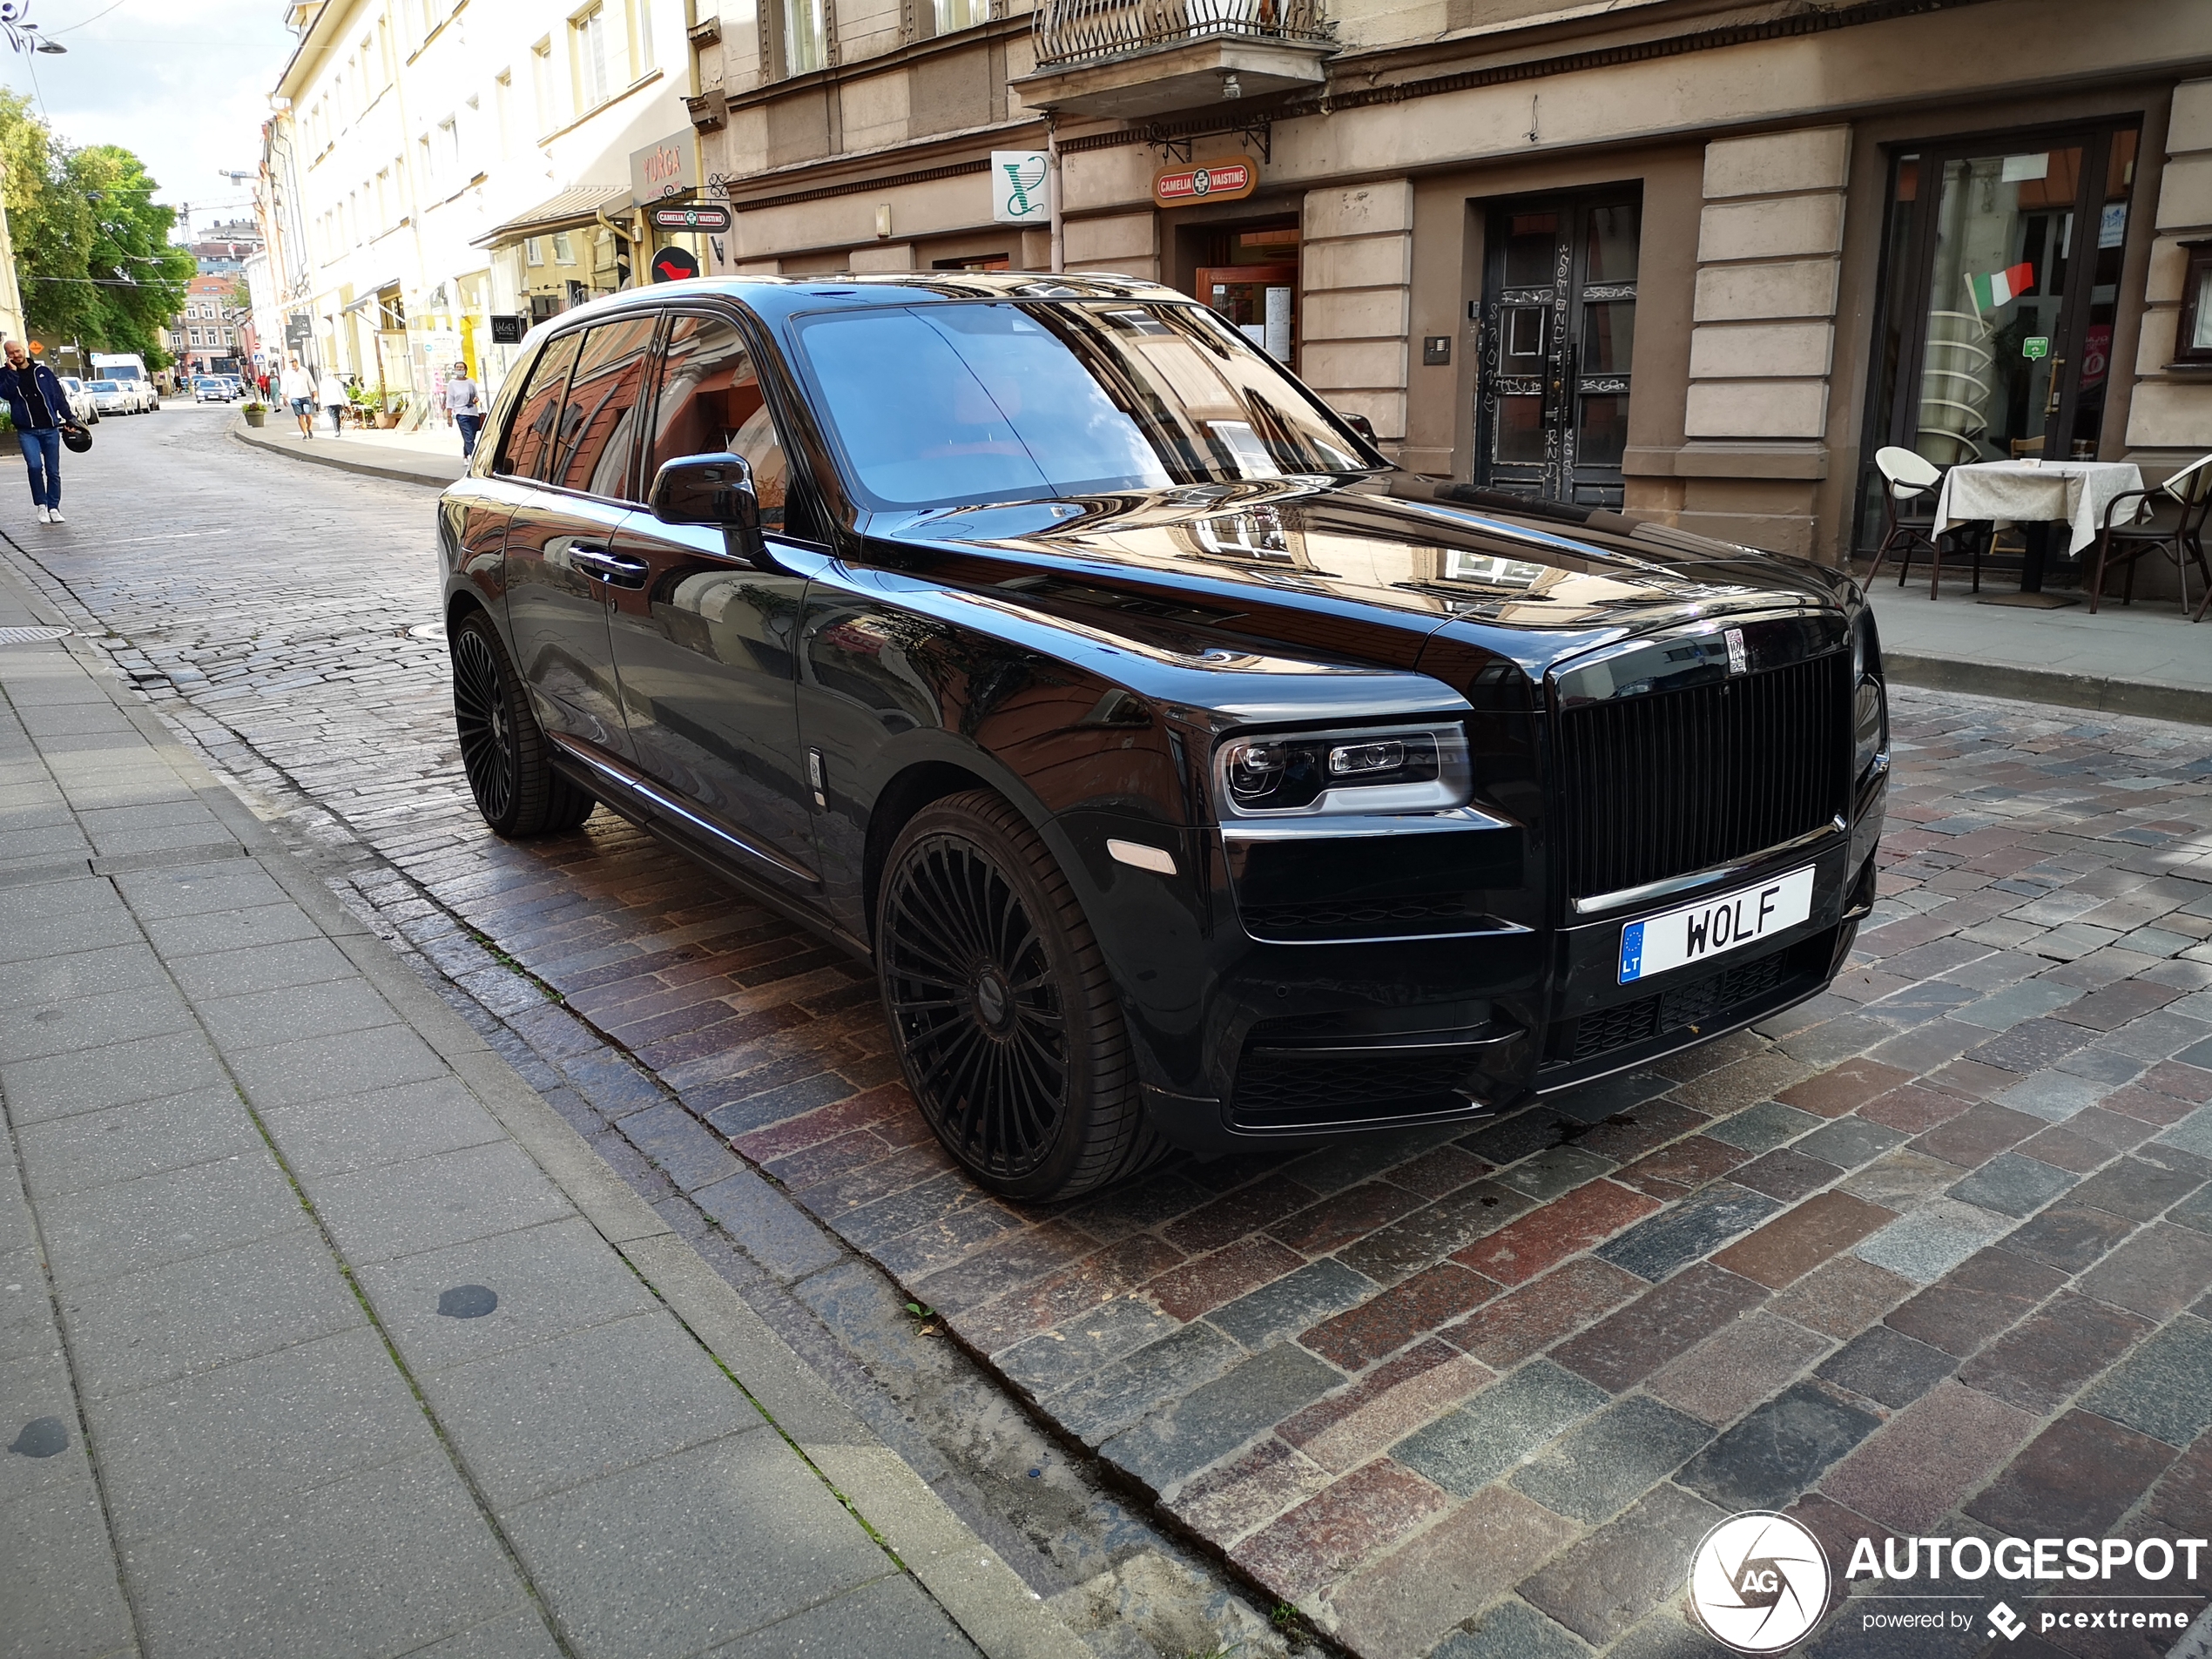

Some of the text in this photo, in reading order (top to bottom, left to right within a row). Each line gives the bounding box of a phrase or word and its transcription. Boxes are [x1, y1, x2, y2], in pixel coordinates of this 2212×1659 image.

[1160, 170, 1244, 192] CAMELIA VAISTINĖ
[659, 213, 685, 222] CAMELIA
[1686, 885, 1781, 959] WOLF
[1622, 957, 1640, 974] LT
